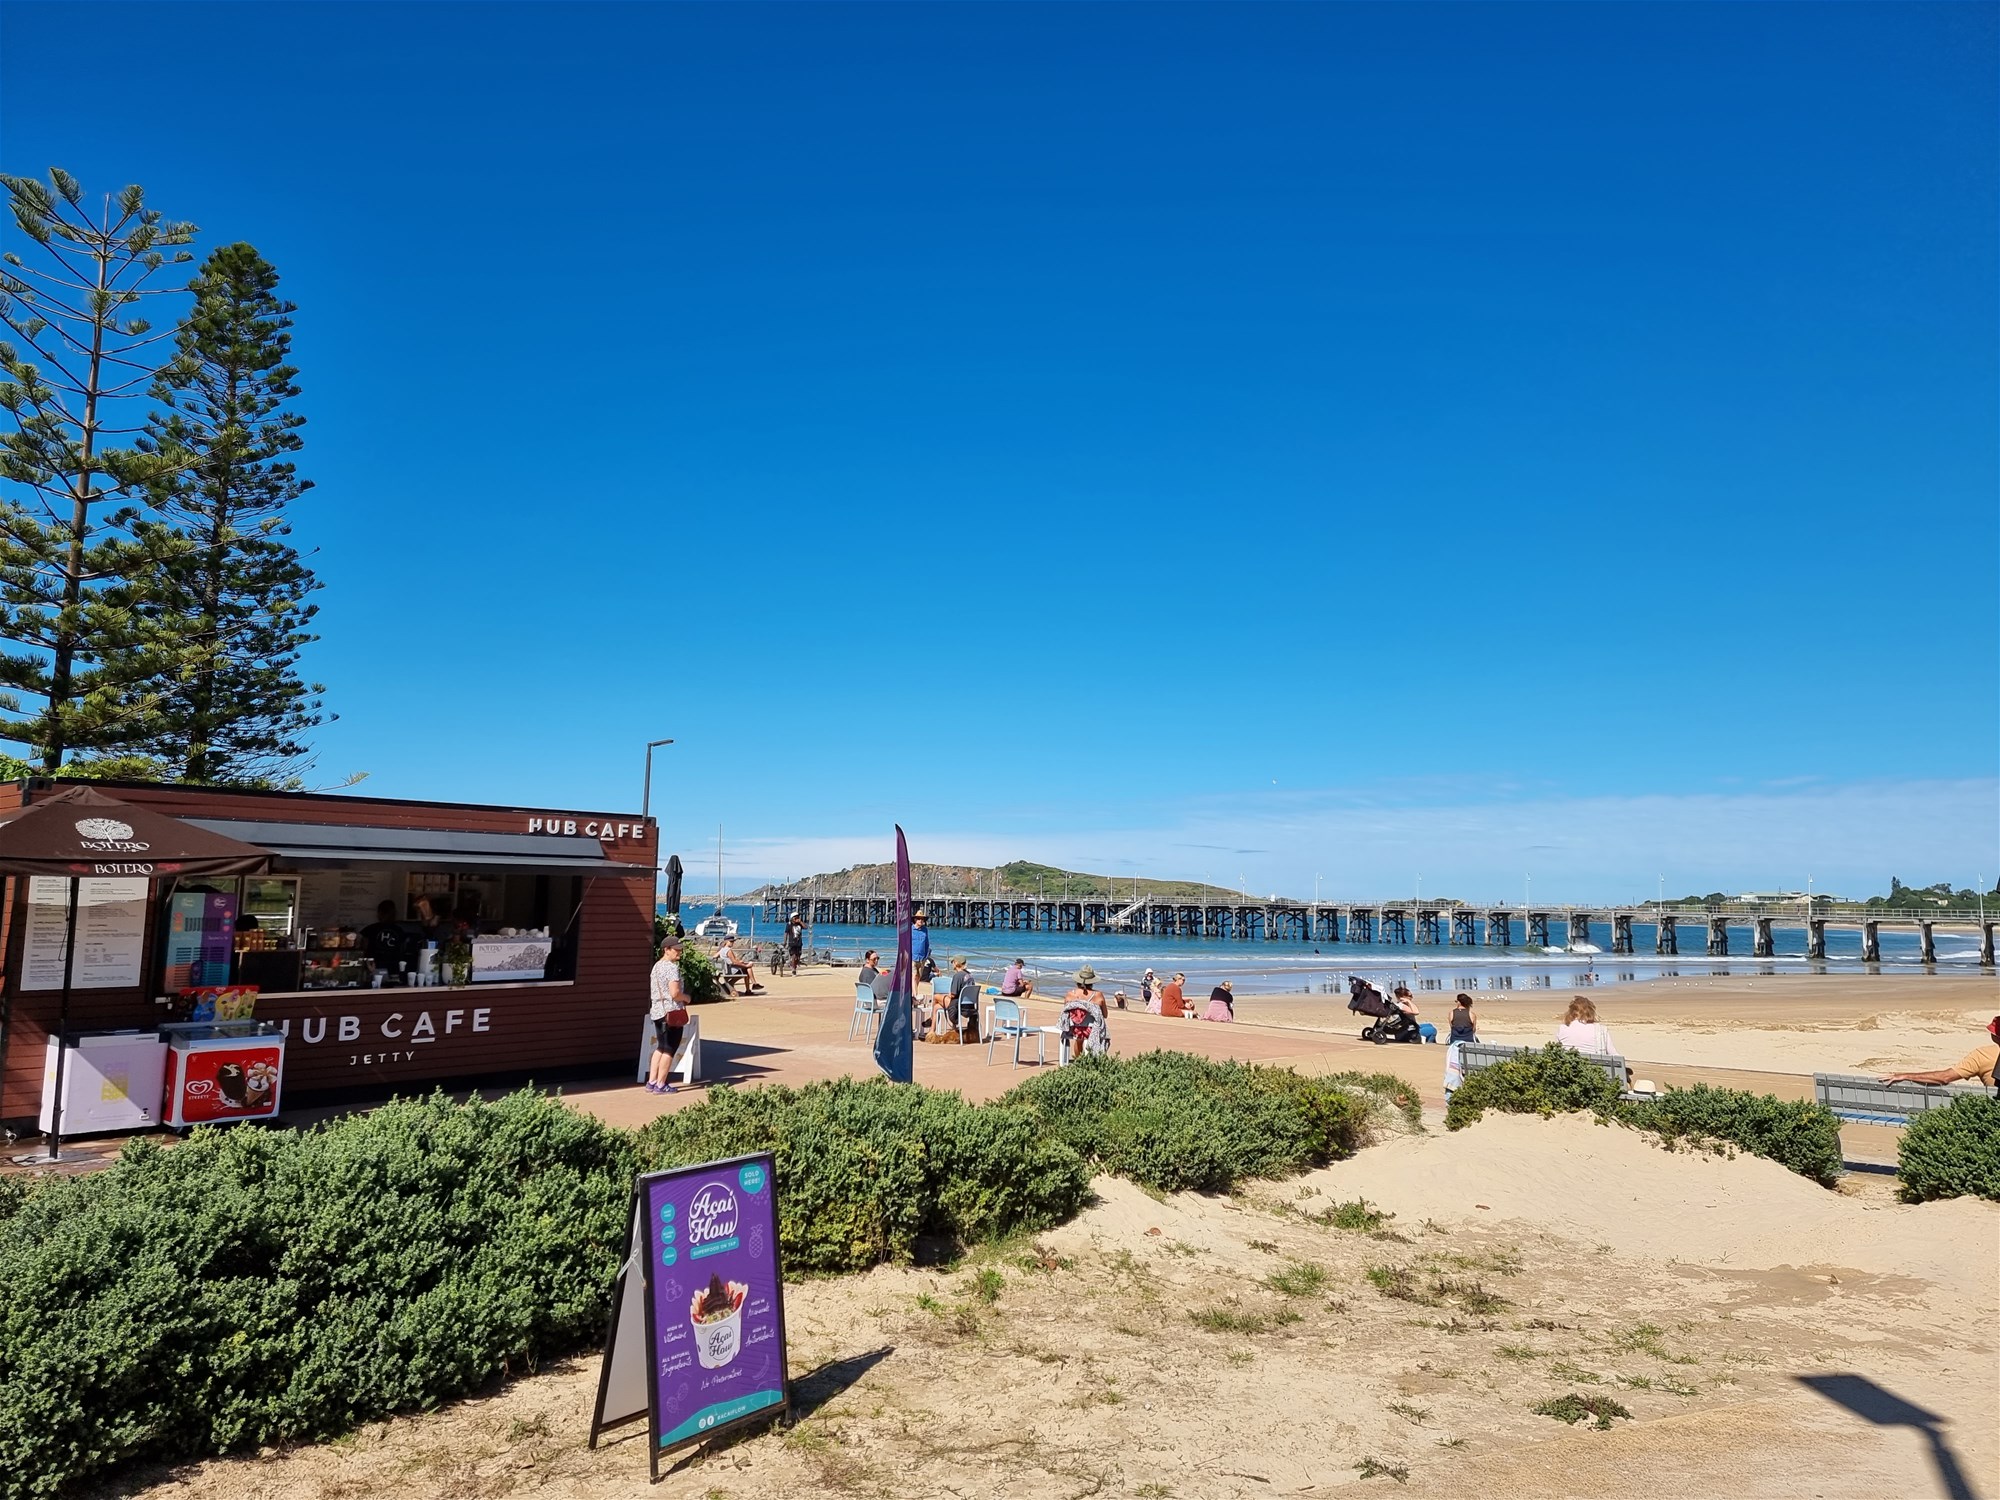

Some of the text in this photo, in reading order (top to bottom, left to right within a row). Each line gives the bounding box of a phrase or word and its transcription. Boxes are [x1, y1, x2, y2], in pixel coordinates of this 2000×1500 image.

[528, 818, 644, 841] HUB CAFE
[80, 841, 150, 851] BOTERO
[94, 863, 153, 875] BOTERO
[381, 1008, 491, 1043] CAFE
[350, 1051, 414, 1066] JETTY
[743, 1178, 760, 1186] HERE!
[744, 1170, 760, 1179] SOLD
[690, 1190, 734, 1220] Açai
[689, 1217, 734, 1244] Flow
[693, 1245, 720, 1256] SUPERFOOD
[728, 1240, 737, 1249] TAP
[670, 1351, 690, 1361] NATURAL
[709, 1342, 733, 1357] Flow
